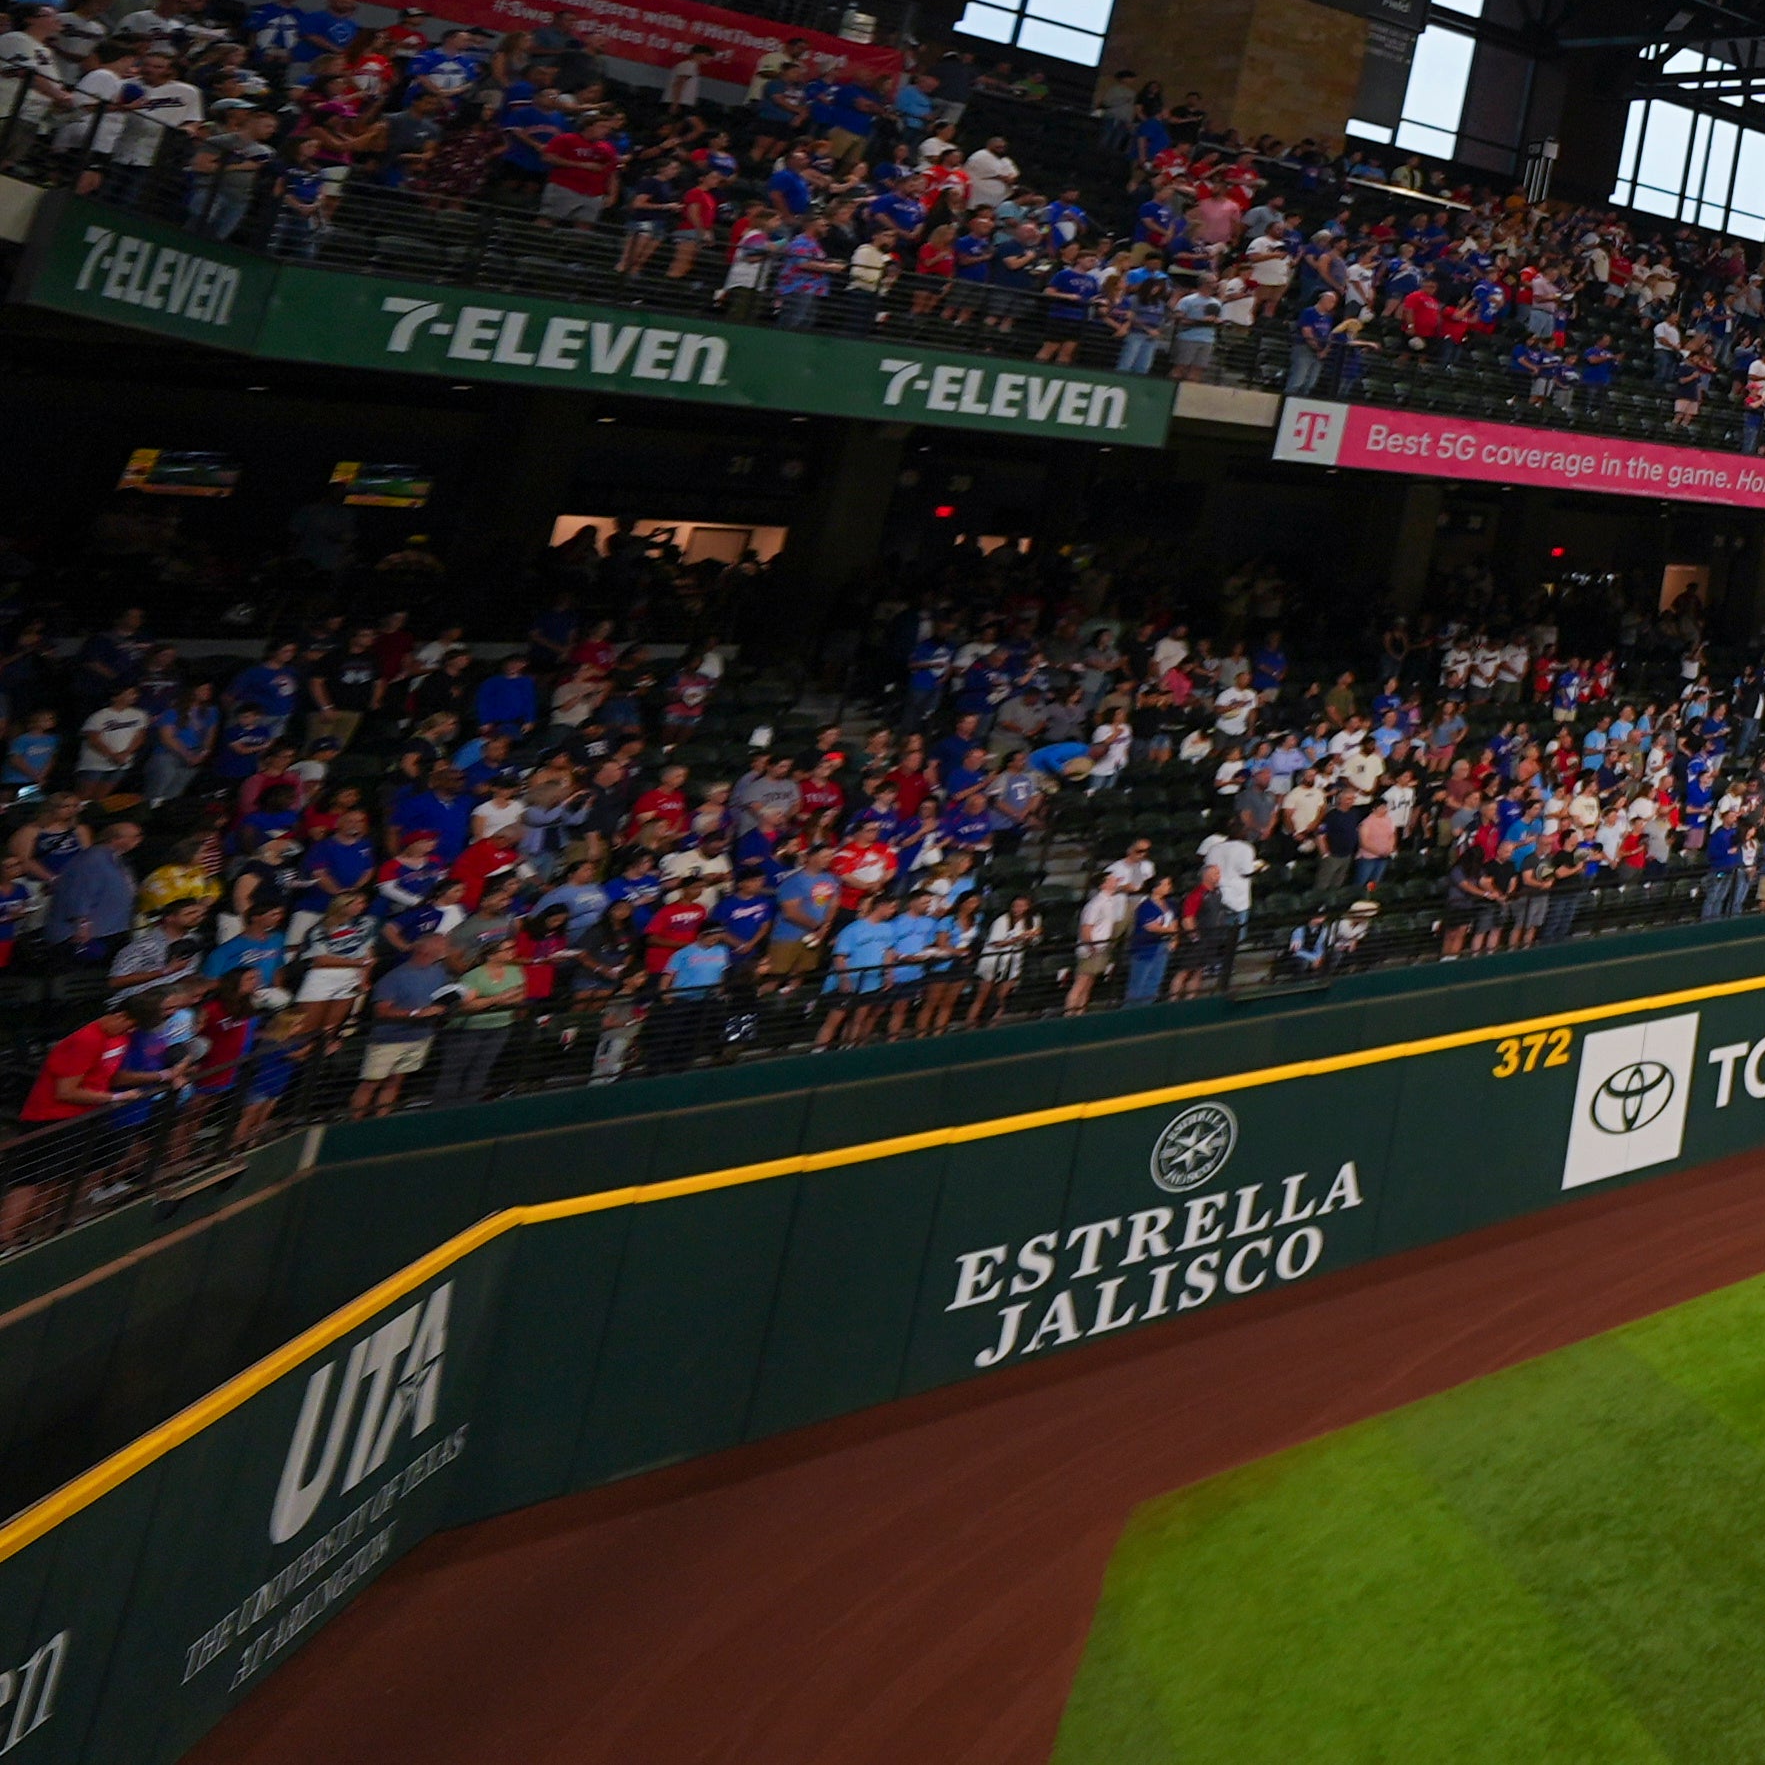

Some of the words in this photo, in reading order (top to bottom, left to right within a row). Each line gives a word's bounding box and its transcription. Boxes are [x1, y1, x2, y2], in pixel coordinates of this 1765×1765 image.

[642, 9, 690, 32] with
[1365, 422, 1432, 457] Best
[1435, 431, 1478, 461] 5G
[1481, 443, 1596, 478] coverage
[1600, 451, 1622, 477] in
[1626, 456, 1664, 481] the
[1666, 464, 1733, 490] game.
[1491, 1027, 1573, 1079] 372
[944, 1160, 1364, 1315] ESTRELLA
[974, 1225, 1325, 1369] JALISCO
[268, 1277, 455, 1545] UTA
